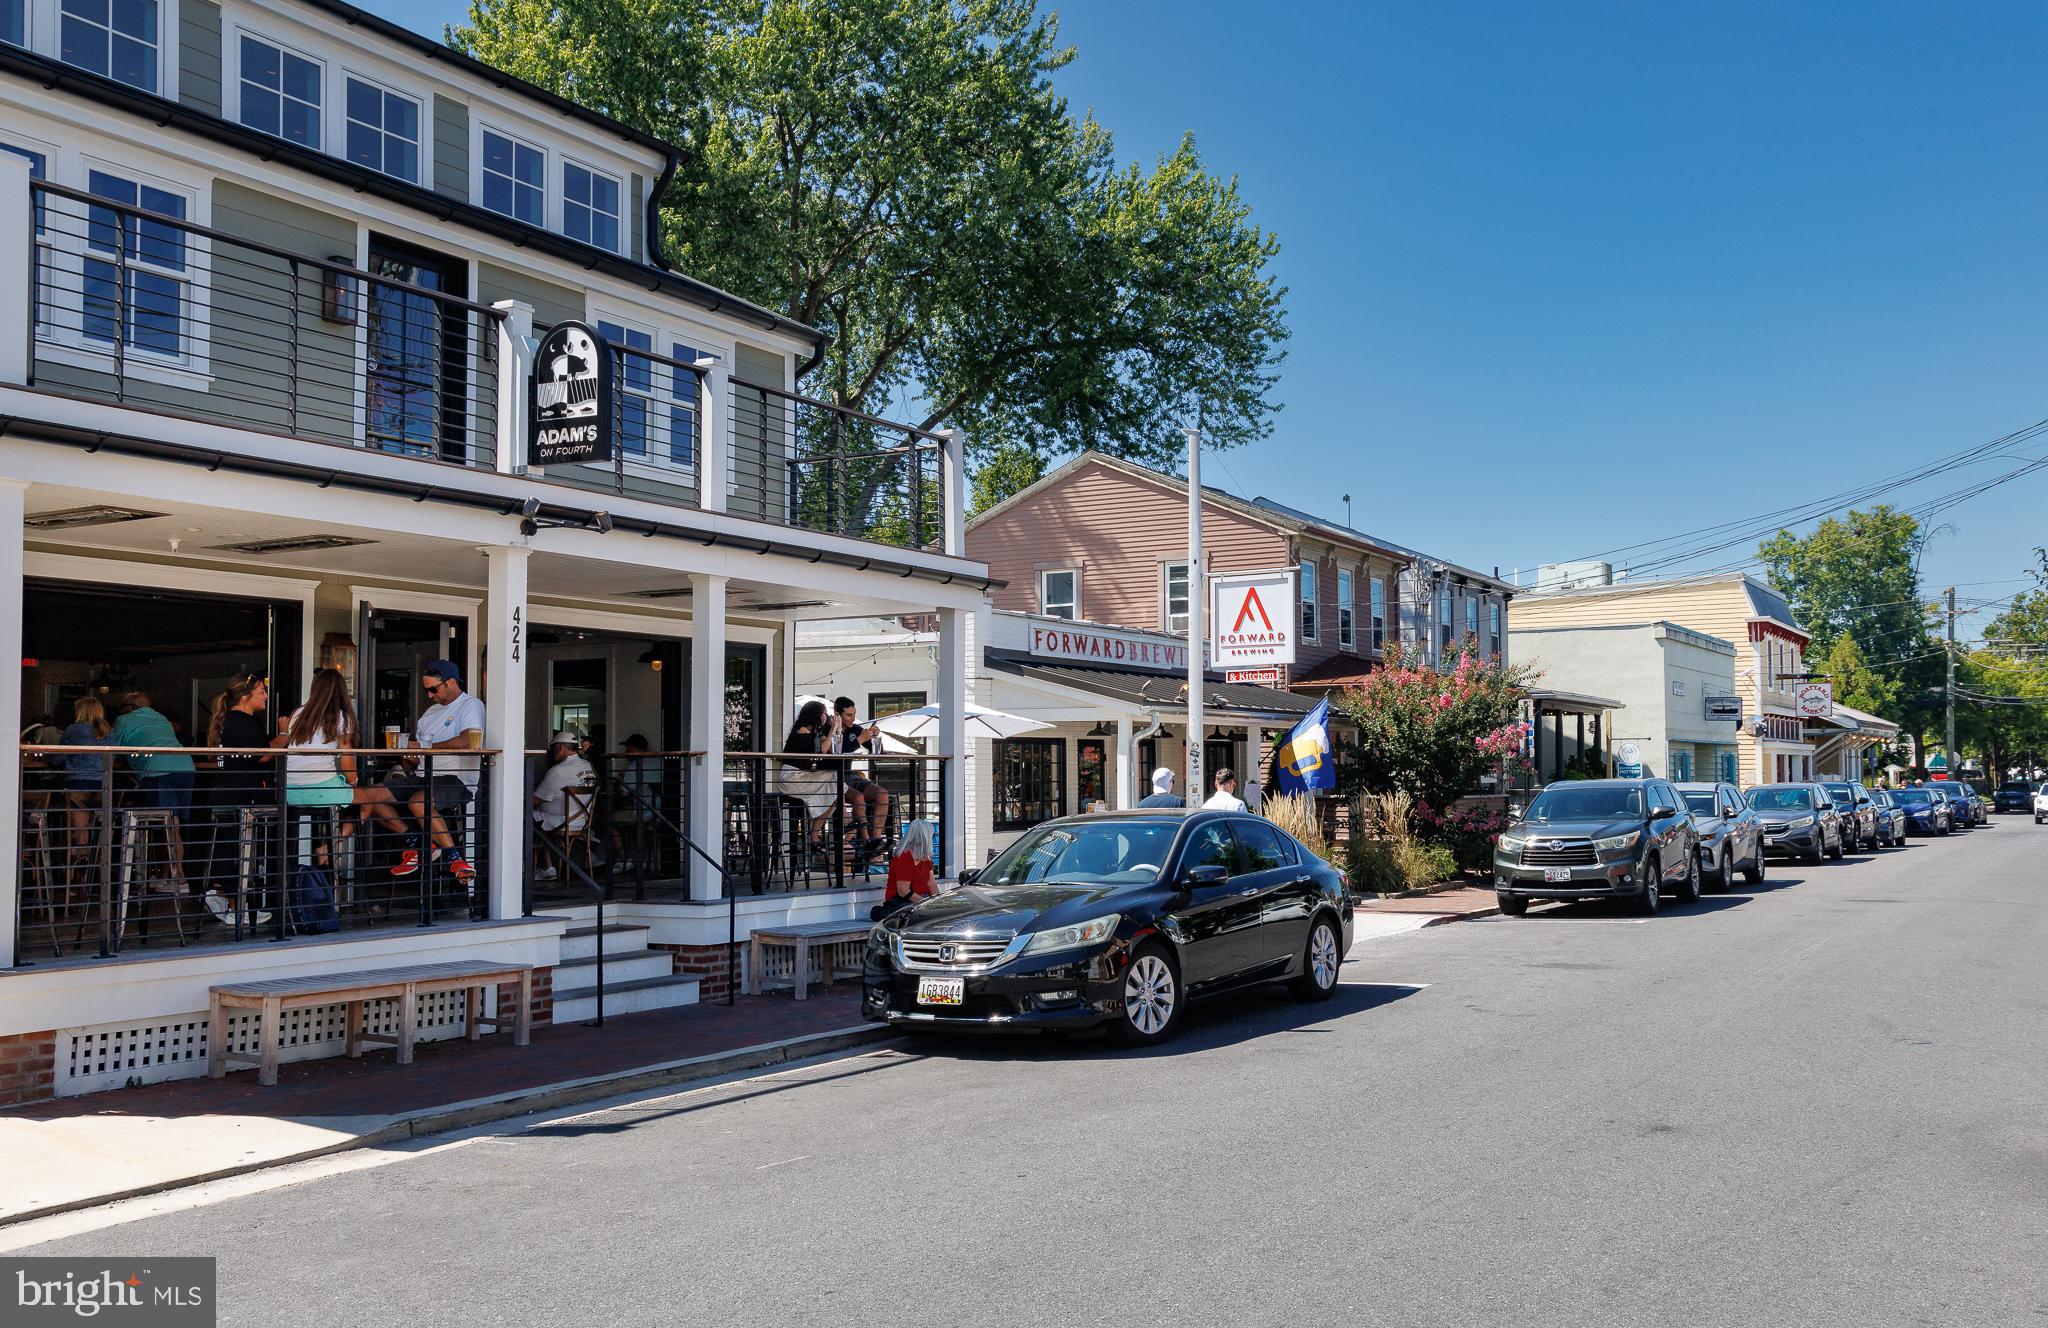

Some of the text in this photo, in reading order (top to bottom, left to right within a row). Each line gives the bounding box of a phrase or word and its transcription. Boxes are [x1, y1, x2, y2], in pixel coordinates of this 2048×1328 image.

[537, 425, 597, 445] ADAM'S
[540, 445, 593, 457] ON FOURTH
[512, 606, 520, 663] 424
[1221, 633, 1285, 644] FORWARD
[1229, 671, 1274, 681] & Kitchen
